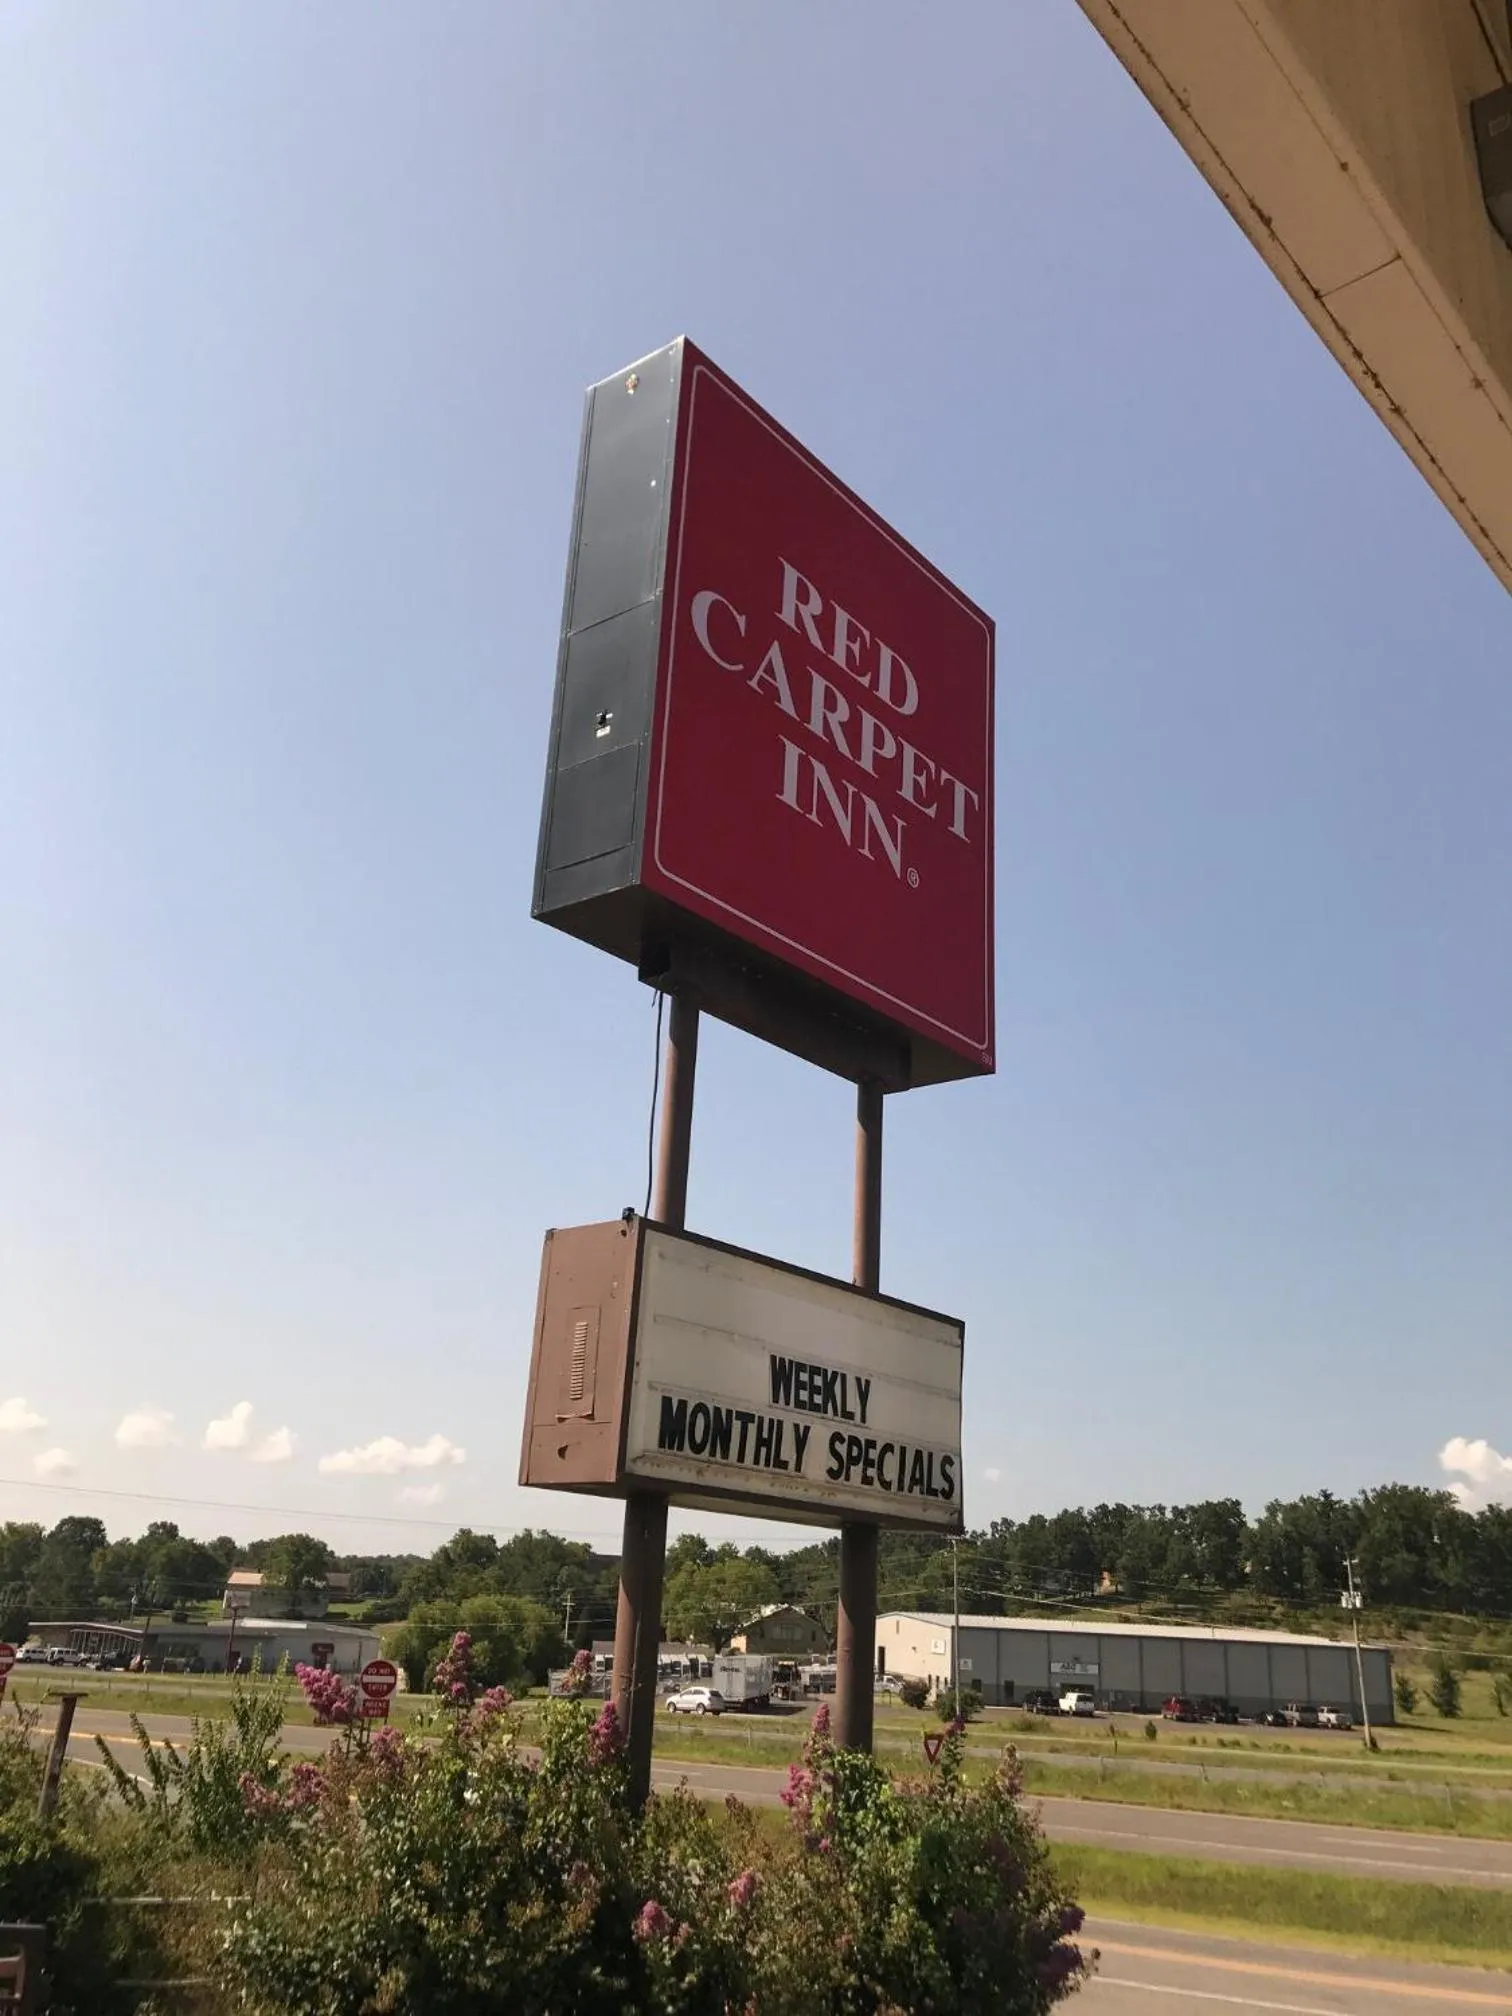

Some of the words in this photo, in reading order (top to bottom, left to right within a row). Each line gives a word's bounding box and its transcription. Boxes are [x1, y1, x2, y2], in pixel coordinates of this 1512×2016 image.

[775, 556, 919, 716] RED
[690, 590, 979, 843] CARPET
[776, 734, 907, 879] INN
[658, 1395, 811, 1473] MONTHLY
[826, 1431, 955, 1500] SPECIALS
[769, 1354, 871, 1425] WEEKLY
